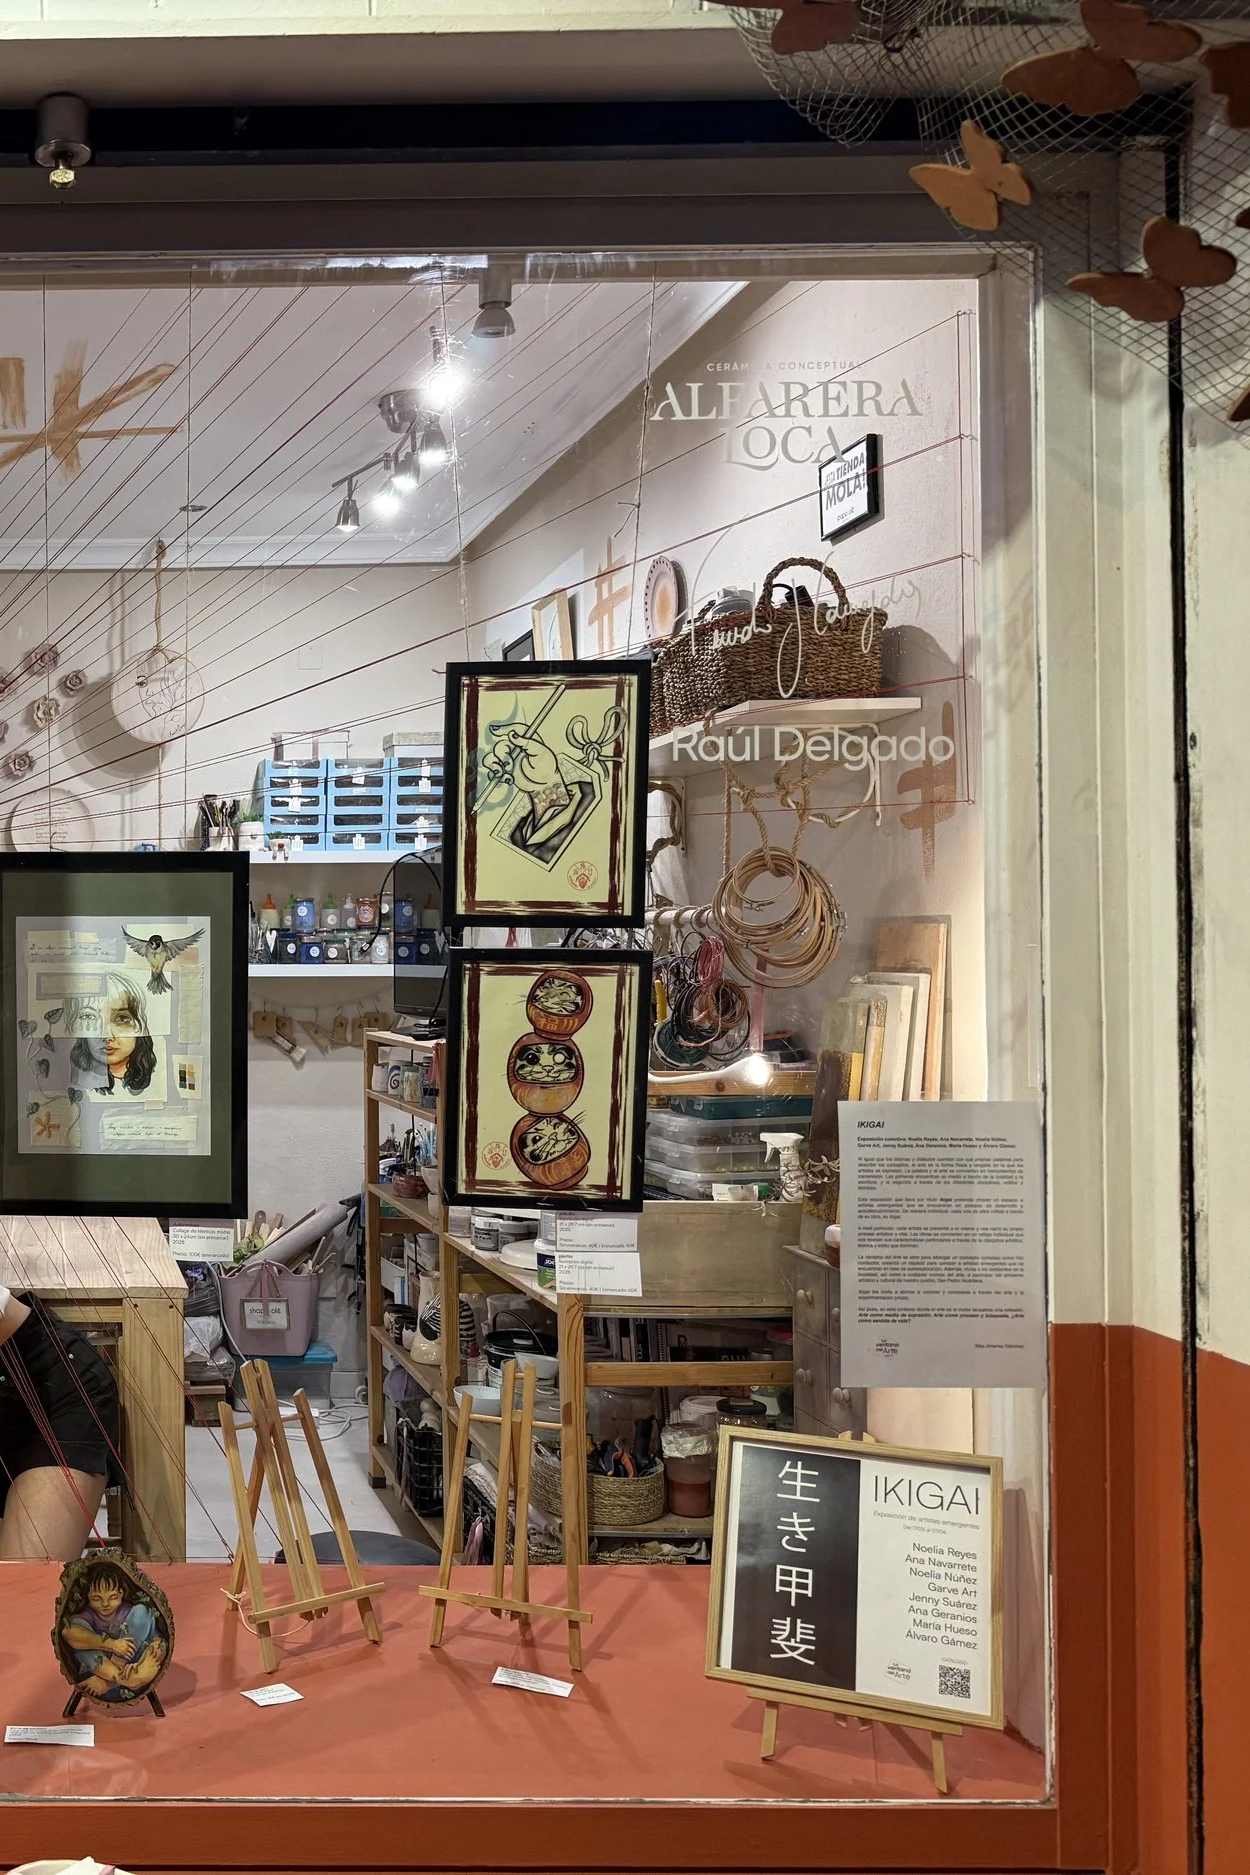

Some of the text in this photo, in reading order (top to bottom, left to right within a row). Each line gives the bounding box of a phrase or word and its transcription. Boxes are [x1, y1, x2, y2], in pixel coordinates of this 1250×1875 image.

[650, 378, 923, 420] ALFARERA
[719, 426, 849, 472] LOCA
[836, 452, 864, 480] TIENDA
[825, 467, 865, 510] MOLA!
[672, 726, 954, 771] Raúl Delgado
[874, 1475, 979, 1515] IKIGAI
[912, 1542, 977, 1560] Noelia Reyes
[770, 1460, 820, 1666] 生き甲斐
[905, 1554, 977, 1572] Ana Navarrete
[909, 1567, 977, 1585] Noelia Núñez
[928, 1583, 977, 1598] Garve Art
[909, 1593, 977, 1611] Jenny Suárez
[908, 1605, 977, 1624] Ana Geranios
[913, 1618, 977, 1637] María Hueso
[905, 1630, 977, 1650] Álvaro Gámez
